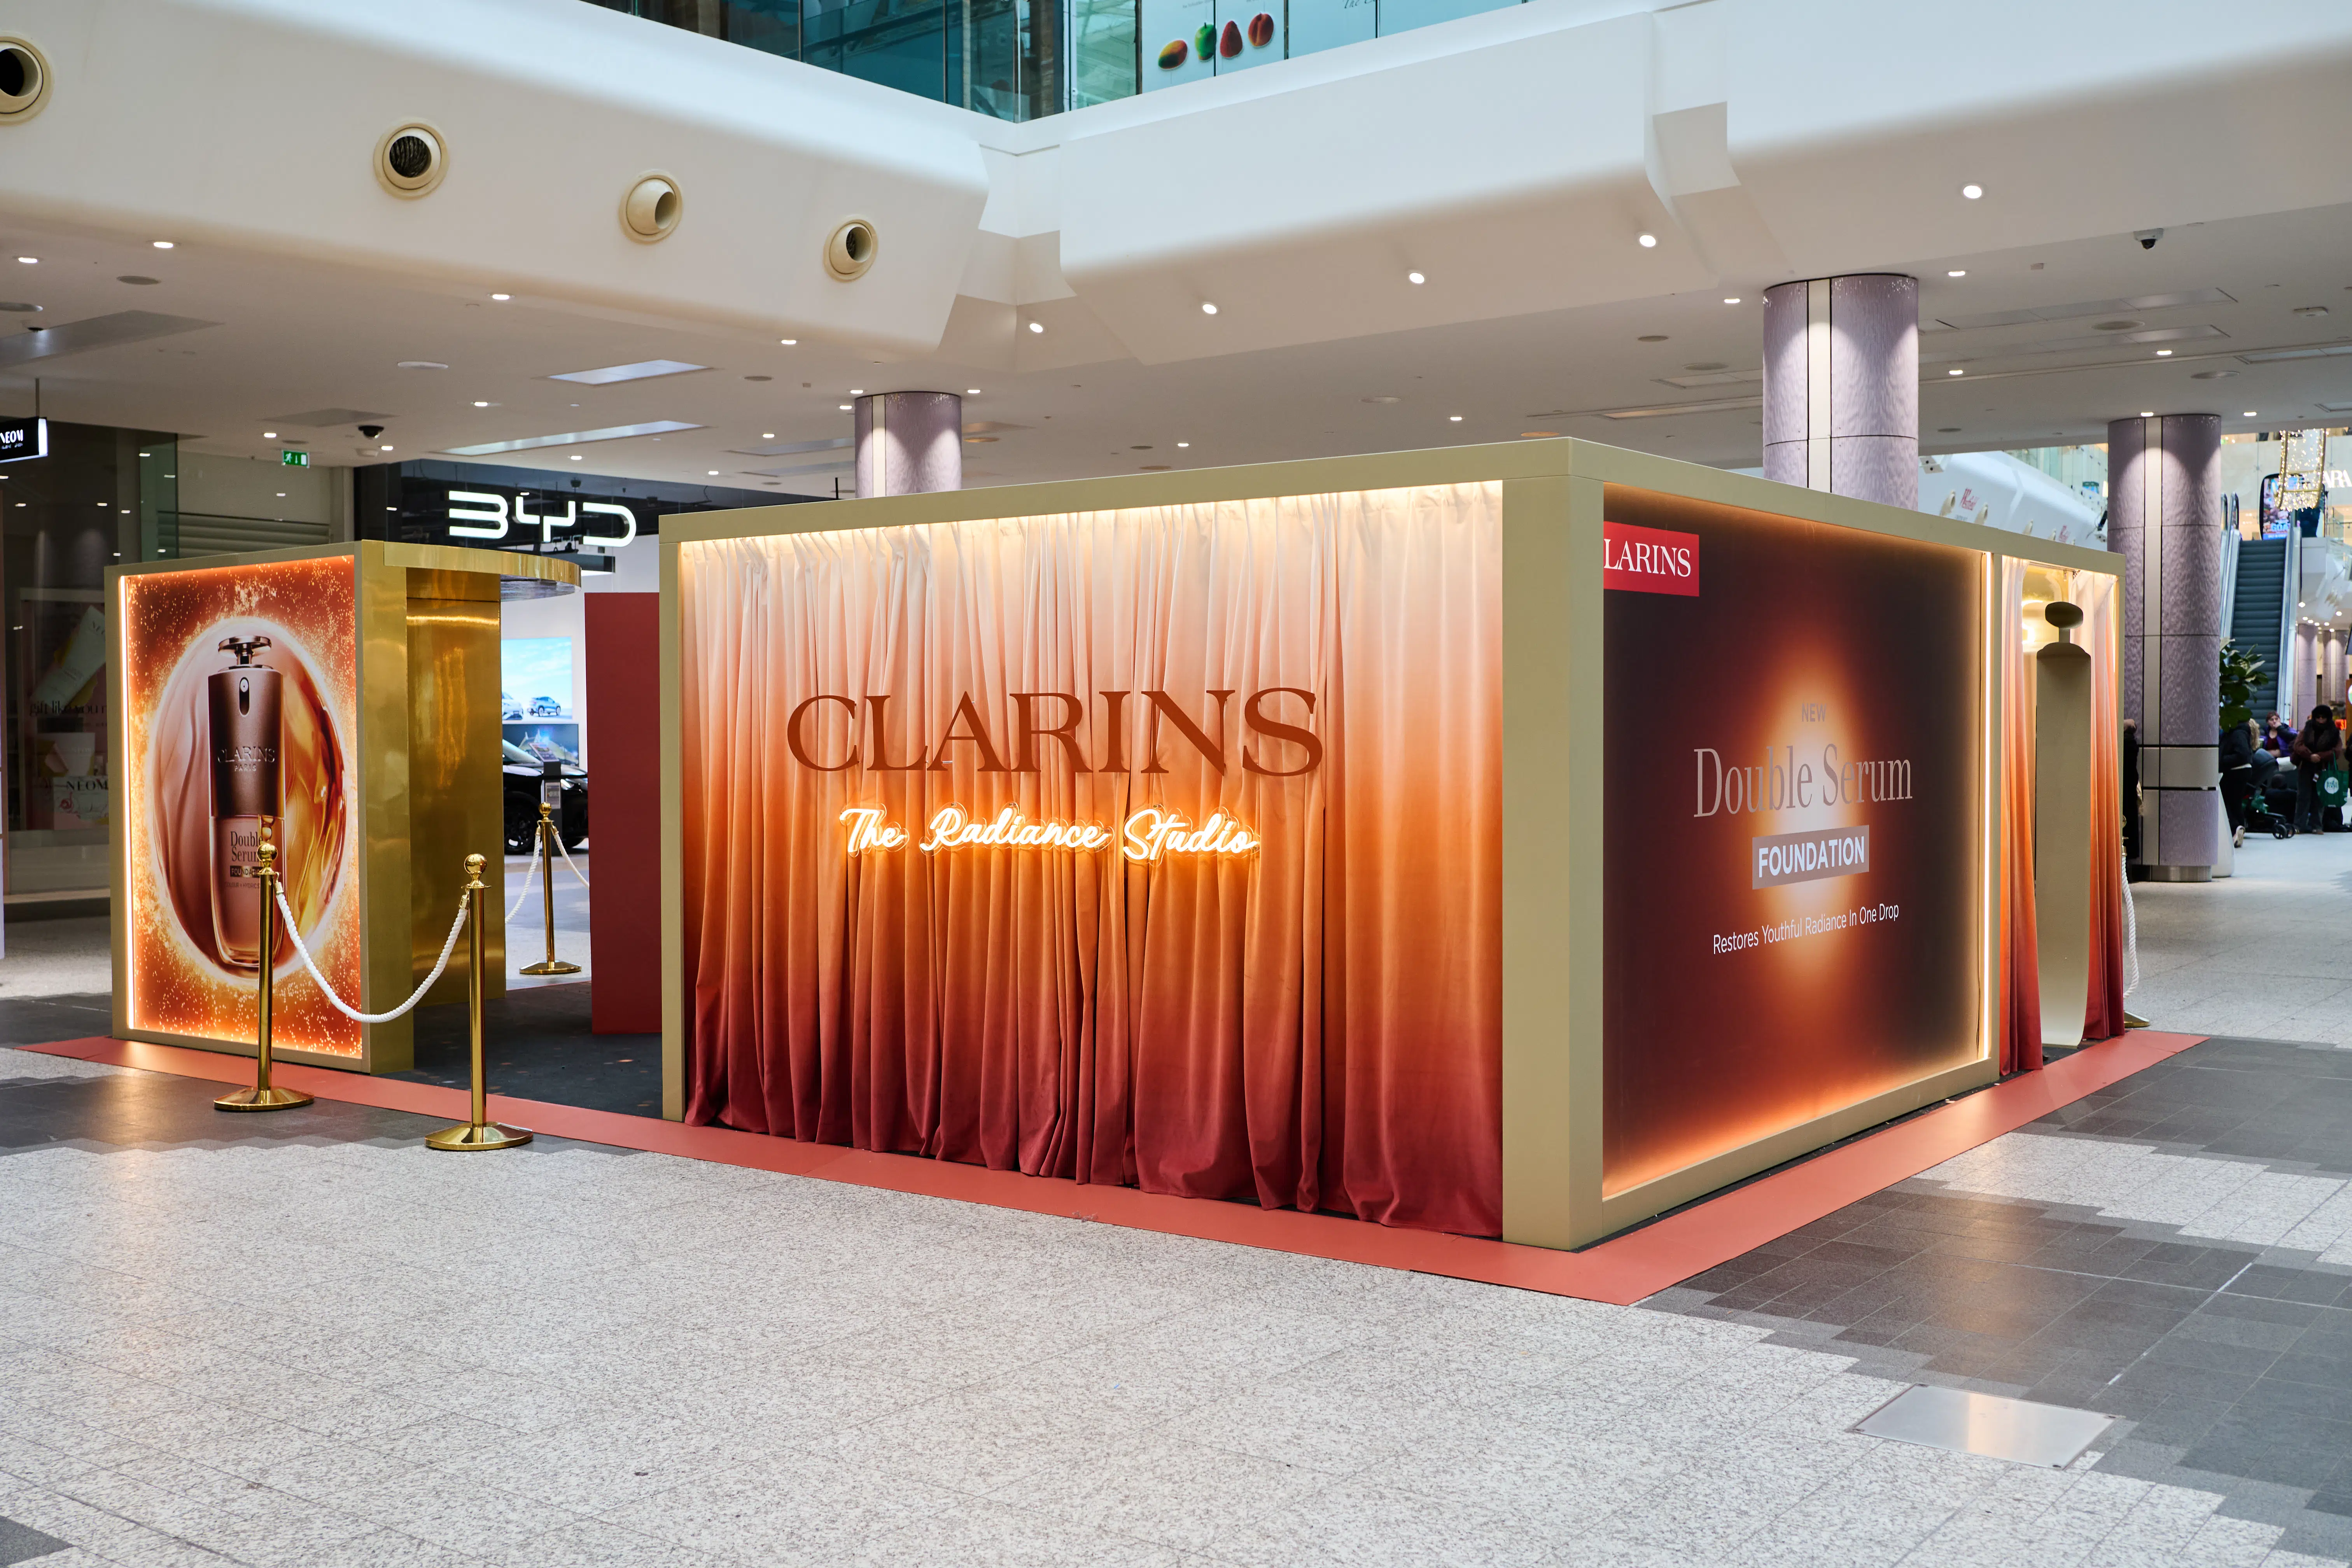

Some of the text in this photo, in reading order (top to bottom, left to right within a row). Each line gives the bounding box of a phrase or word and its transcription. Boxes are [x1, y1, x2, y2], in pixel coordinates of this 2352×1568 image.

[2322, 469, 2352, 488] ARA
[447, 490, 637, 548] BYD
[787, 687, 1323, 777] CLARINS
[1802, 703, 1827, 722] NEW
[217, 746, 275, 763] CLARINS
[234, 763, 257, 772] PARIS
[1694, 743, 1913, 817] Double Serum
[231, 831, 263, 847] Double
[839, 805, 1261, 860] The Radiance Studio
[1759, 835, 1865, 878] FOUNDATION
[1713, 903, 1899, 954] Restores Youthful Radiance In One Drop
